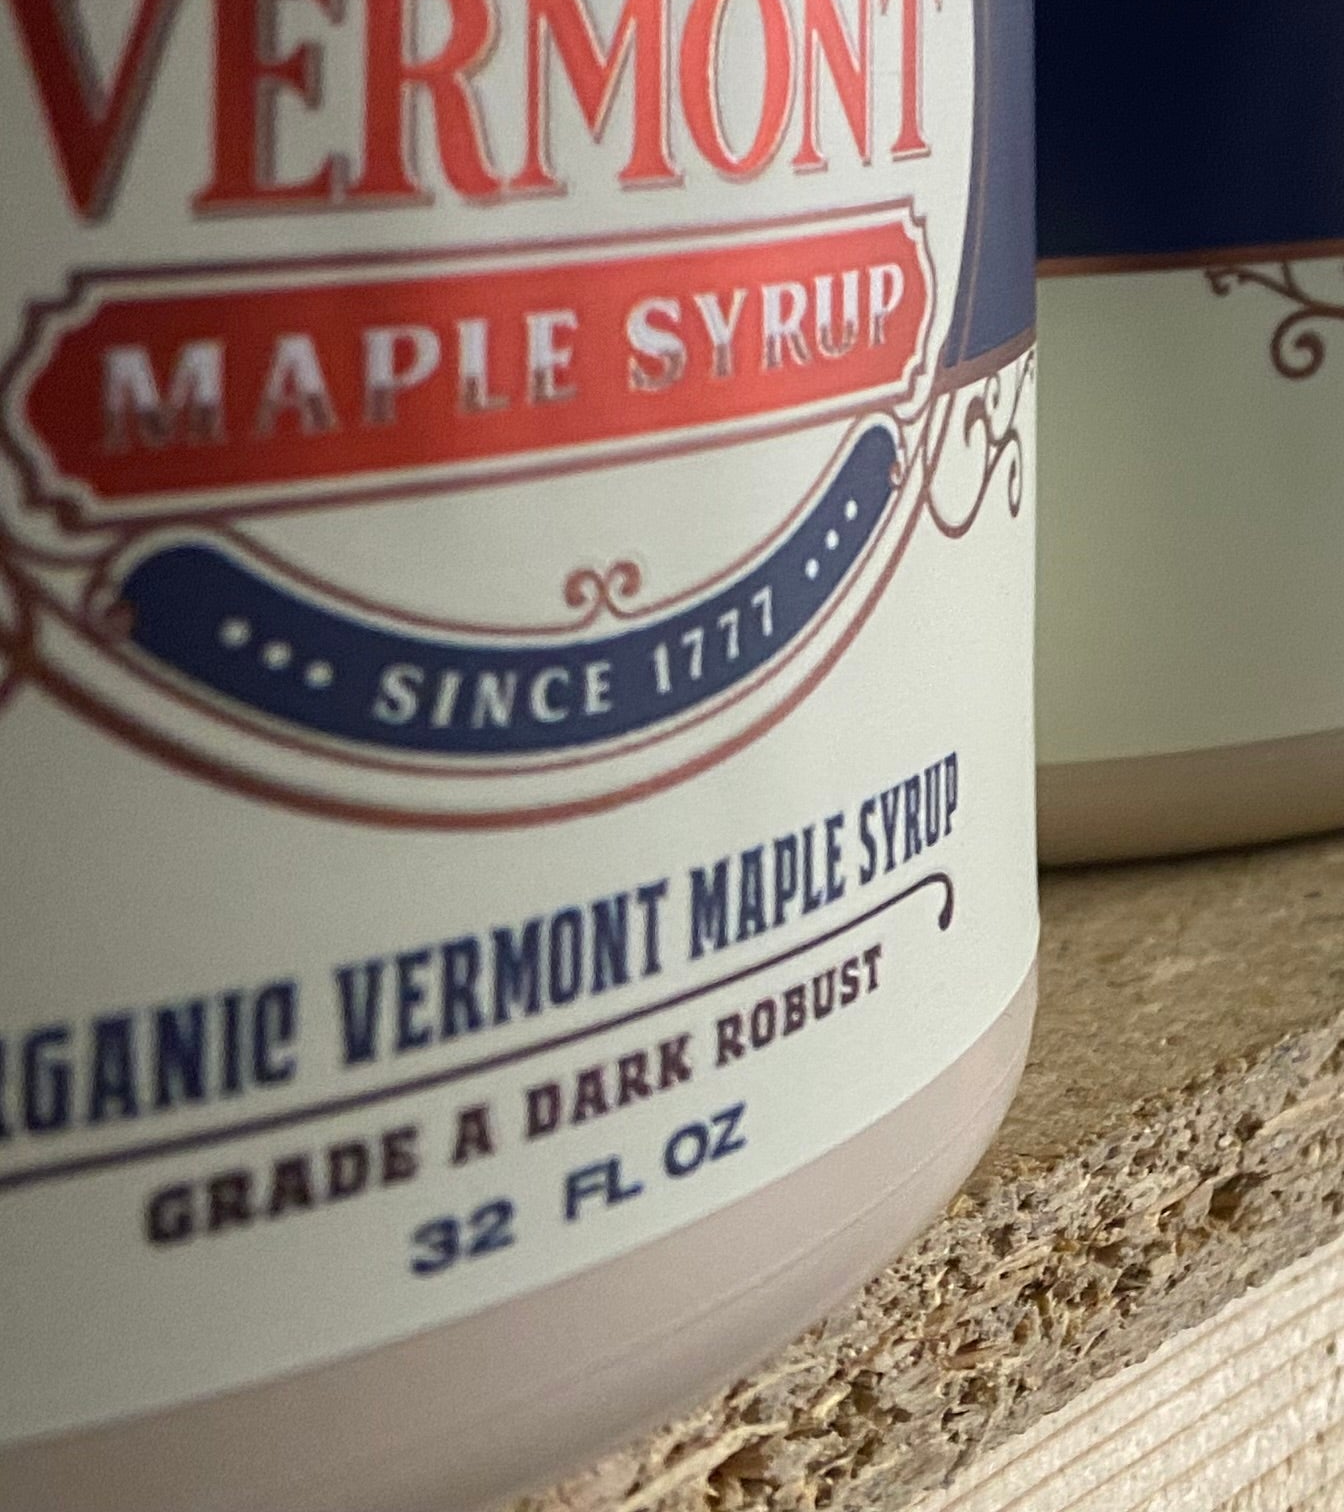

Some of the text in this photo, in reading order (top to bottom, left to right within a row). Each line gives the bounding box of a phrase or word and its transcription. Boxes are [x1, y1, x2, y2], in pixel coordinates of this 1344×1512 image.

[102, 262, 906, 454] MAPLE SYRUP
[372, 586, 775, 729] SINCE 1777
[0, 750, 960, 1140] GANIC VERMONT MAPLE SYRUP
[146, 944, 883, 1247] GRADE A DARK ROBUST
[409, 1102, 749, 1278] 32 FL OZ
